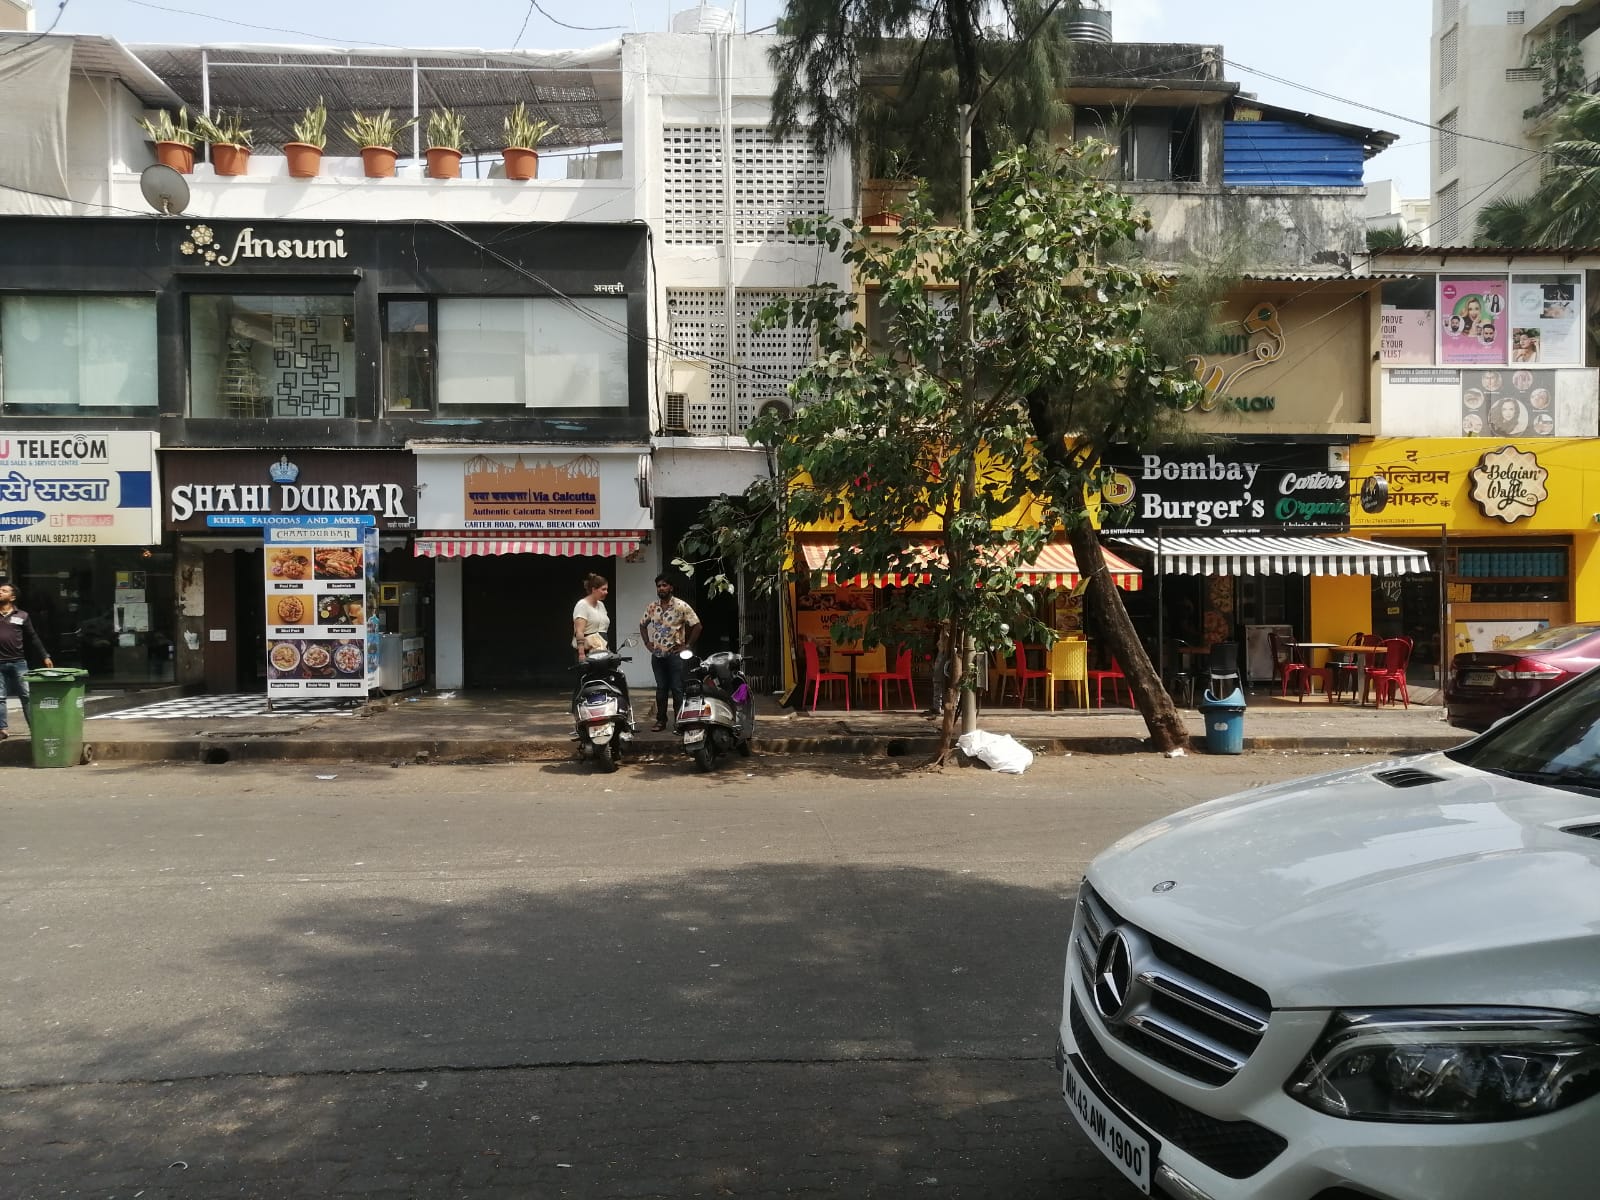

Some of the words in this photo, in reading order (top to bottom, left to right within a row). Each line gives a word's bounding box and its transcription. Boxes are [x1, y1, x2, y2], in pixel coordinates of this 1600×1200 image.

[217, 227, 348, 267] Ansuni
[1382, 350, 1402, 358] YLIST
[1223, 396, 1276, 412] ALON
[17, 439, 107, 459] TELECOM
[1141, 454, 1261, 489] Bombay
[1487, 462, 1539, 485] Belgian
[33, 478, 110, 502] सस्ता
[532, 492, 550, 502] Via
[552, 492, 596, 502] Calcutta
[1487, 478, 1531, 510] Waffle
[171, 483, 272, 523] SHAHI
[280, 483, 409, 519] DURBAR
[472, 508, 510, 516] Authentic
[513, 508, 546, 516] Calcutta
[548, 508, 572, 516] Street
[575, 508, 594, 516] Food
[1141, 491, 1265, 527] Burger's
[0, 517, 38, 526] MSUNG
[213, 516, 246, 525] KULFIS,
[252, 516, 301, 525] FALOODAS
[306, 516, 329, 525] AND
[464, 521, 492, 529] CARTER
[494, 521, 516, 530] ROAD,
[518, 521, 544, 530] POWAI,
[546, 521, 575, 529] BREACH
[577, 521, 600, 529] CANDY
[10, 535, 24, 543] MR.
[26, 535, 52, 543] KUNAL
[53, 535, 96, 543] 9821737373
[1066, 1069, 1142, 1177] MH.43.AW.1900
